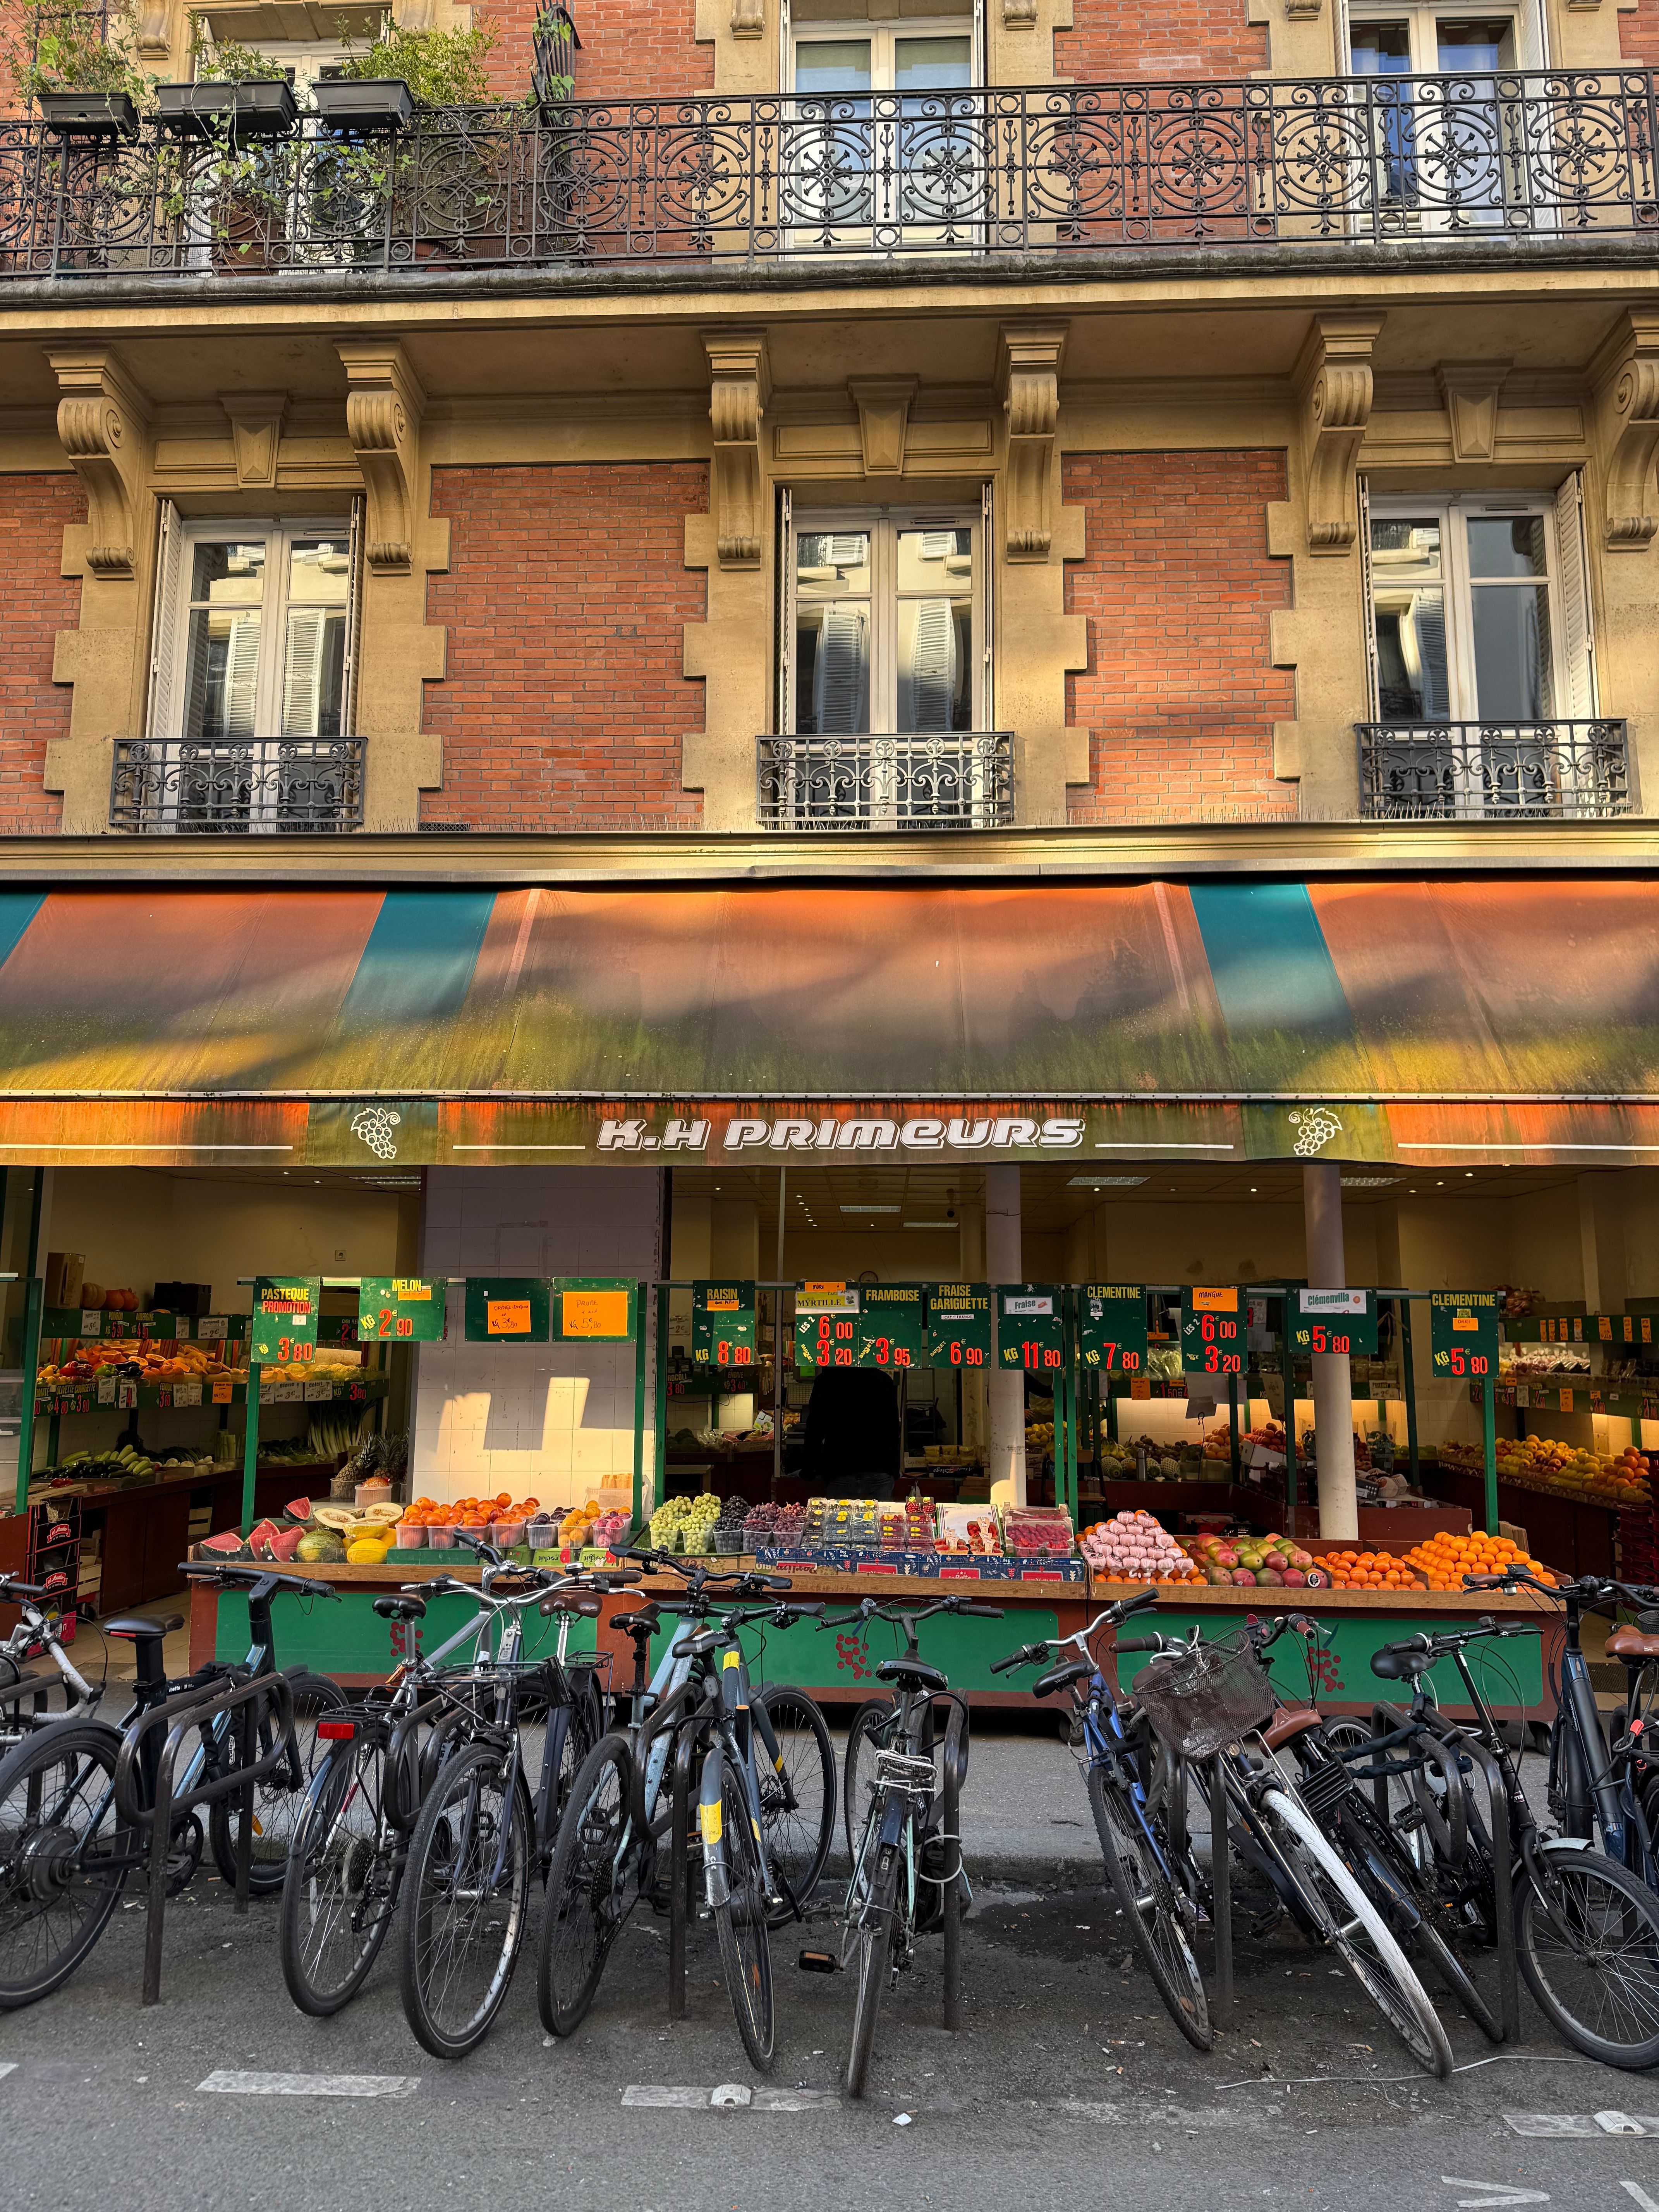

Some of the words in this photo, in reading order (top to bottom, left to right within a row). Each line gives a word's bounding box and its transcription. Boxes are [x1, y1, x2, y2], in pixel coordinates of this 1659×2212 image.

[597, 1119, 713, 1151] K.H
[392, 1279, 422, 1292] MELON
[939, 1285, 971, 1297] FRAISE
[1087, 1286, 1141, 1298] CLEMENTINE
[261, 1288, 309, 1301] PASTEQUE
[707, 1288, 738, 1300] RAISIN
[866, 1289, 919, 1301] FRAMBOISE
[1307, 1292, 1350, 1306] Clémenvilla
[1432, 1293, 1495, 1307] CLEMENTINE
[261, 1300, 311, 1314] PROMOTION
[930, 1297, 988, 1310] GARIGUETTE
[1015, 1300, 1036, 1309] Fraise
[360, 1314, 376, 1330] KG
[491, 1321, 500, 1329] KG
[569, 1320, 579, 1330] KG
[799, 1321, 810, 1333] LES
[1183, 1324, 1195, 1336] LES
[1296, 1330, 1310, 1343] KG
[259, 1344, 270, 1355] KG
[696, 1348, 709, 1361] KG
[1003, 1347, 1018, 1361] KG
[1085, 1350, 1100, 1364] KG
[1434, 1351, 1449, 1366] KG
[333, 1389, 342, 1397] KG
